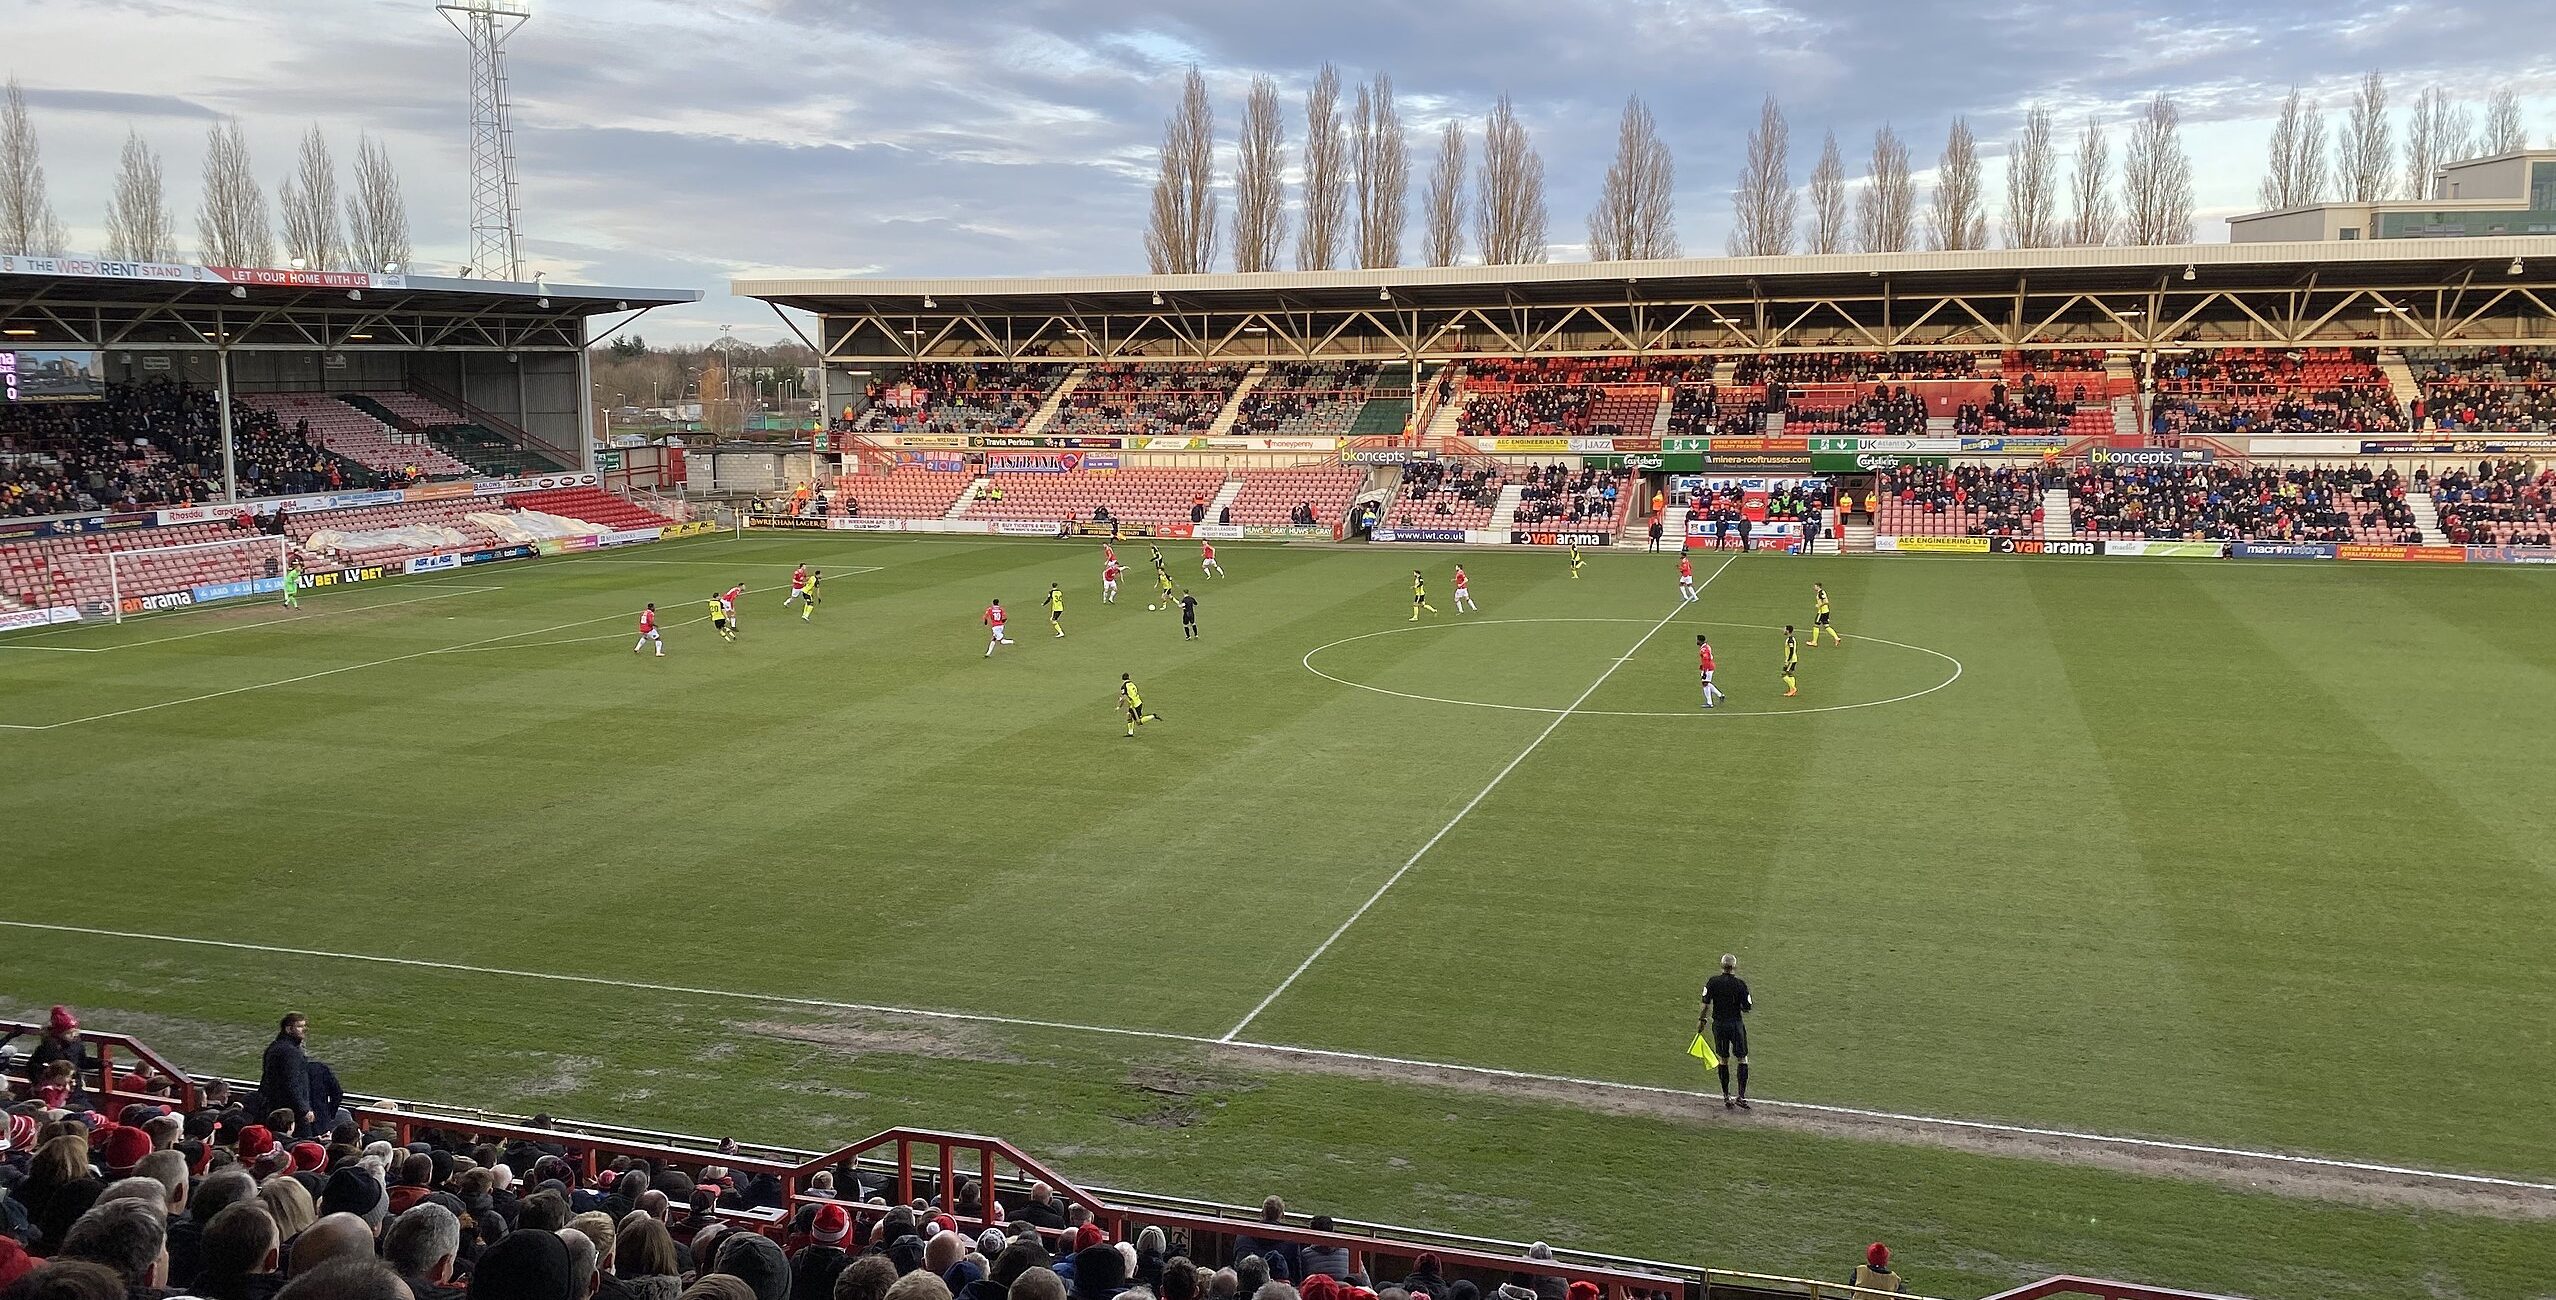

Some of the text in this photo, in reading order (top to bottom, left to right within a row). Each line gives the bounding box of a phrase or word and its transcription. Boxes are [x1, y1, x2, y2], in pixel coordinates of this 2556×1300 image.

[27, 260, 182, 277] THE WREXRENT STAND
[231, 270, 367, 285] LET YOUR HOME WITH US
[6, 374, 16, 386] 0
[7, 387, 17, 399] 0
[985, 438, 1034, 446] Travis Perkins
[1272, 440, 1314, 449] moneypenny
[1588, 440, 1611, 448] JAZZ
[1859, 440, 1877, 449] UK
[1341, 448, 1405, 465] bkoncepts
[1624, 454, 1664, 468] Carlsberg
[1712, 455, 1811, 465] minera-rooftrusses.com
[2091, 447, 2173, 465] bkoncepts
[169, 510, 204, 521] Rhosddu
[756, 518, 820, 527] WREXHAM LAGER
[1245, 526, 1287, 535] HUWS GRAY
[1289, 527, 1333, 536] HUWS GRAY
[1396, 530, 1464, 541] www.iwt.co.uk
[1531, 532, 1600, 545] vanarama
[1758, 540, 1777, 549] AFC
[2015, 540, 2095, 555] vanarama
[117, 591, 191, 614] anarama
